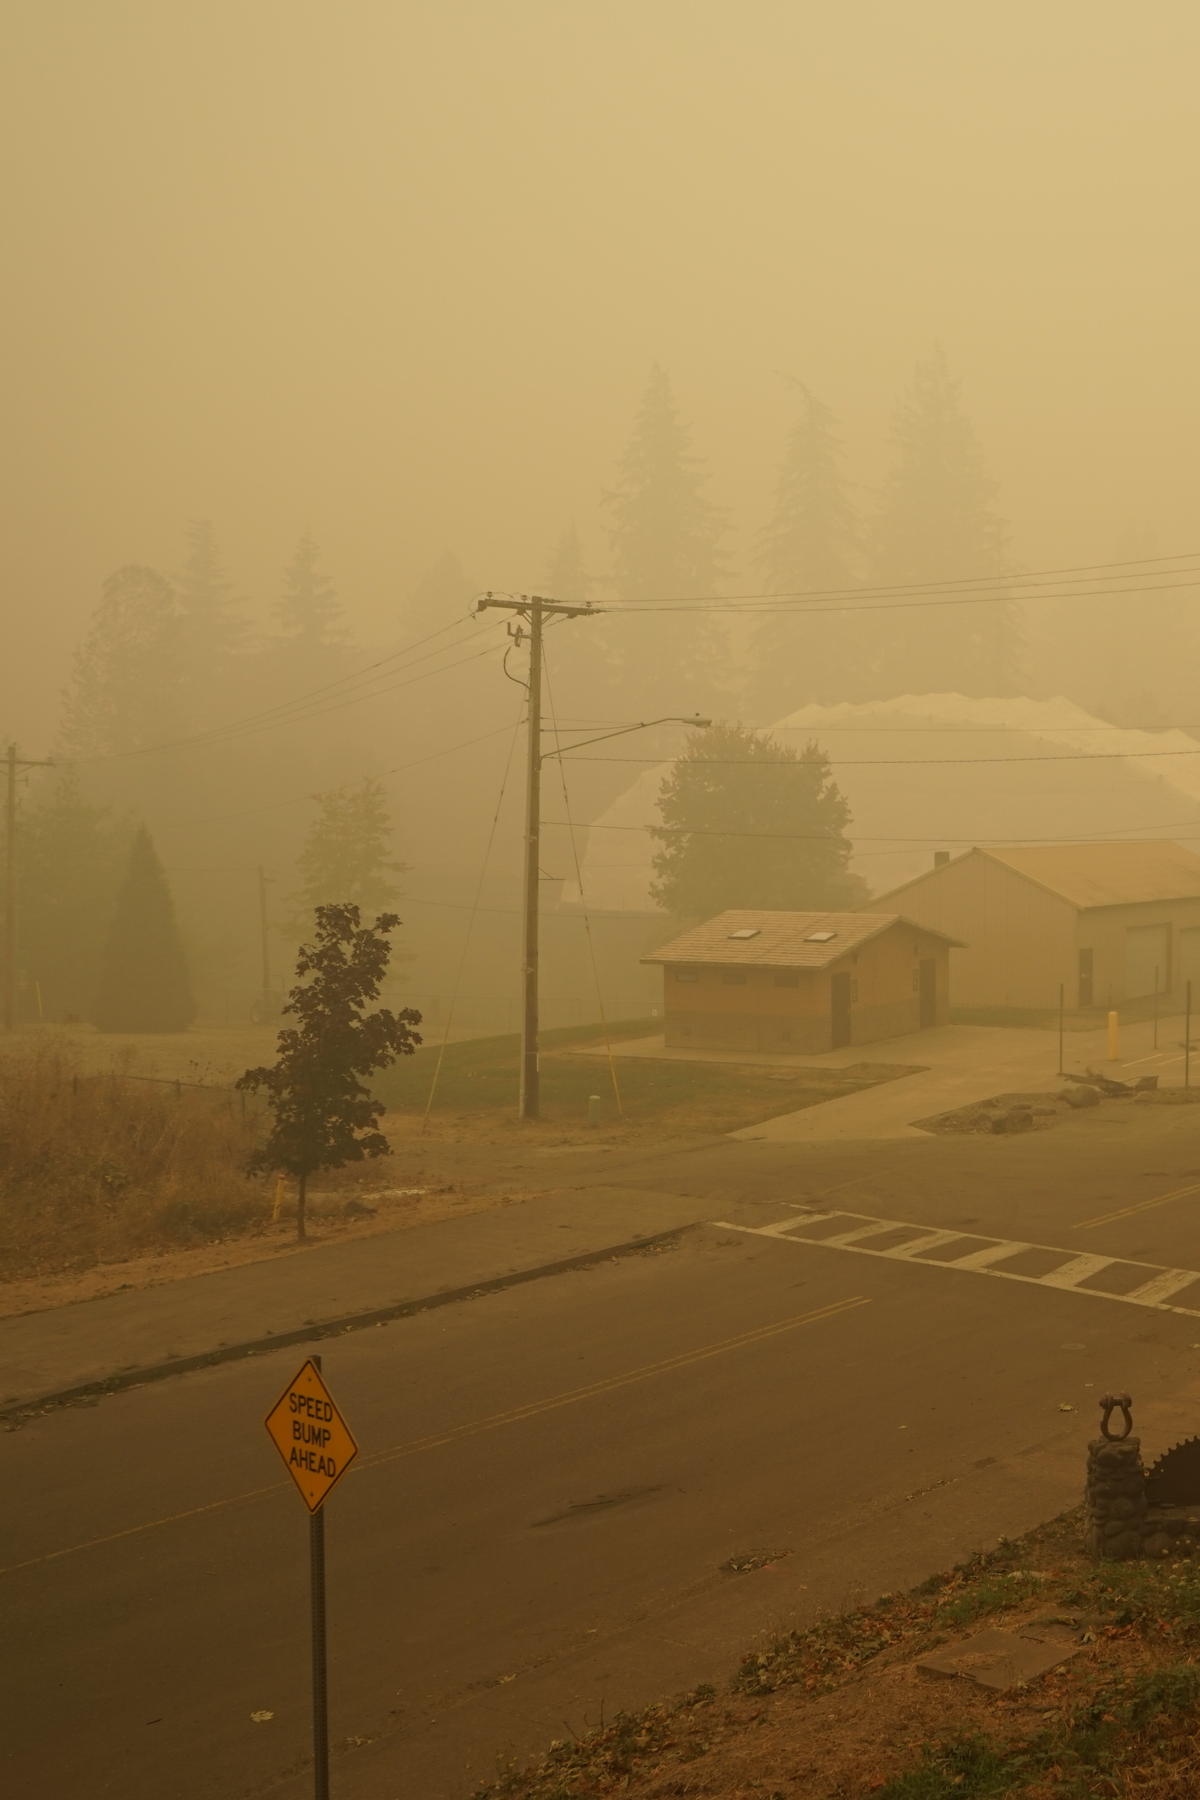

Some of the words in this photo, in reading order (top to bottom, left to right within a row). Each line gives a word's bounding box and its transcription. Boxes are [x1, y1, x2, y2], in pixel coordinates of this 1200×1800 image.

[289, 1392, 333, 1422] SPEED
[292, 1420, 332, 1448] BUMP
[289, 1447, 336, 1478] AHEAD
